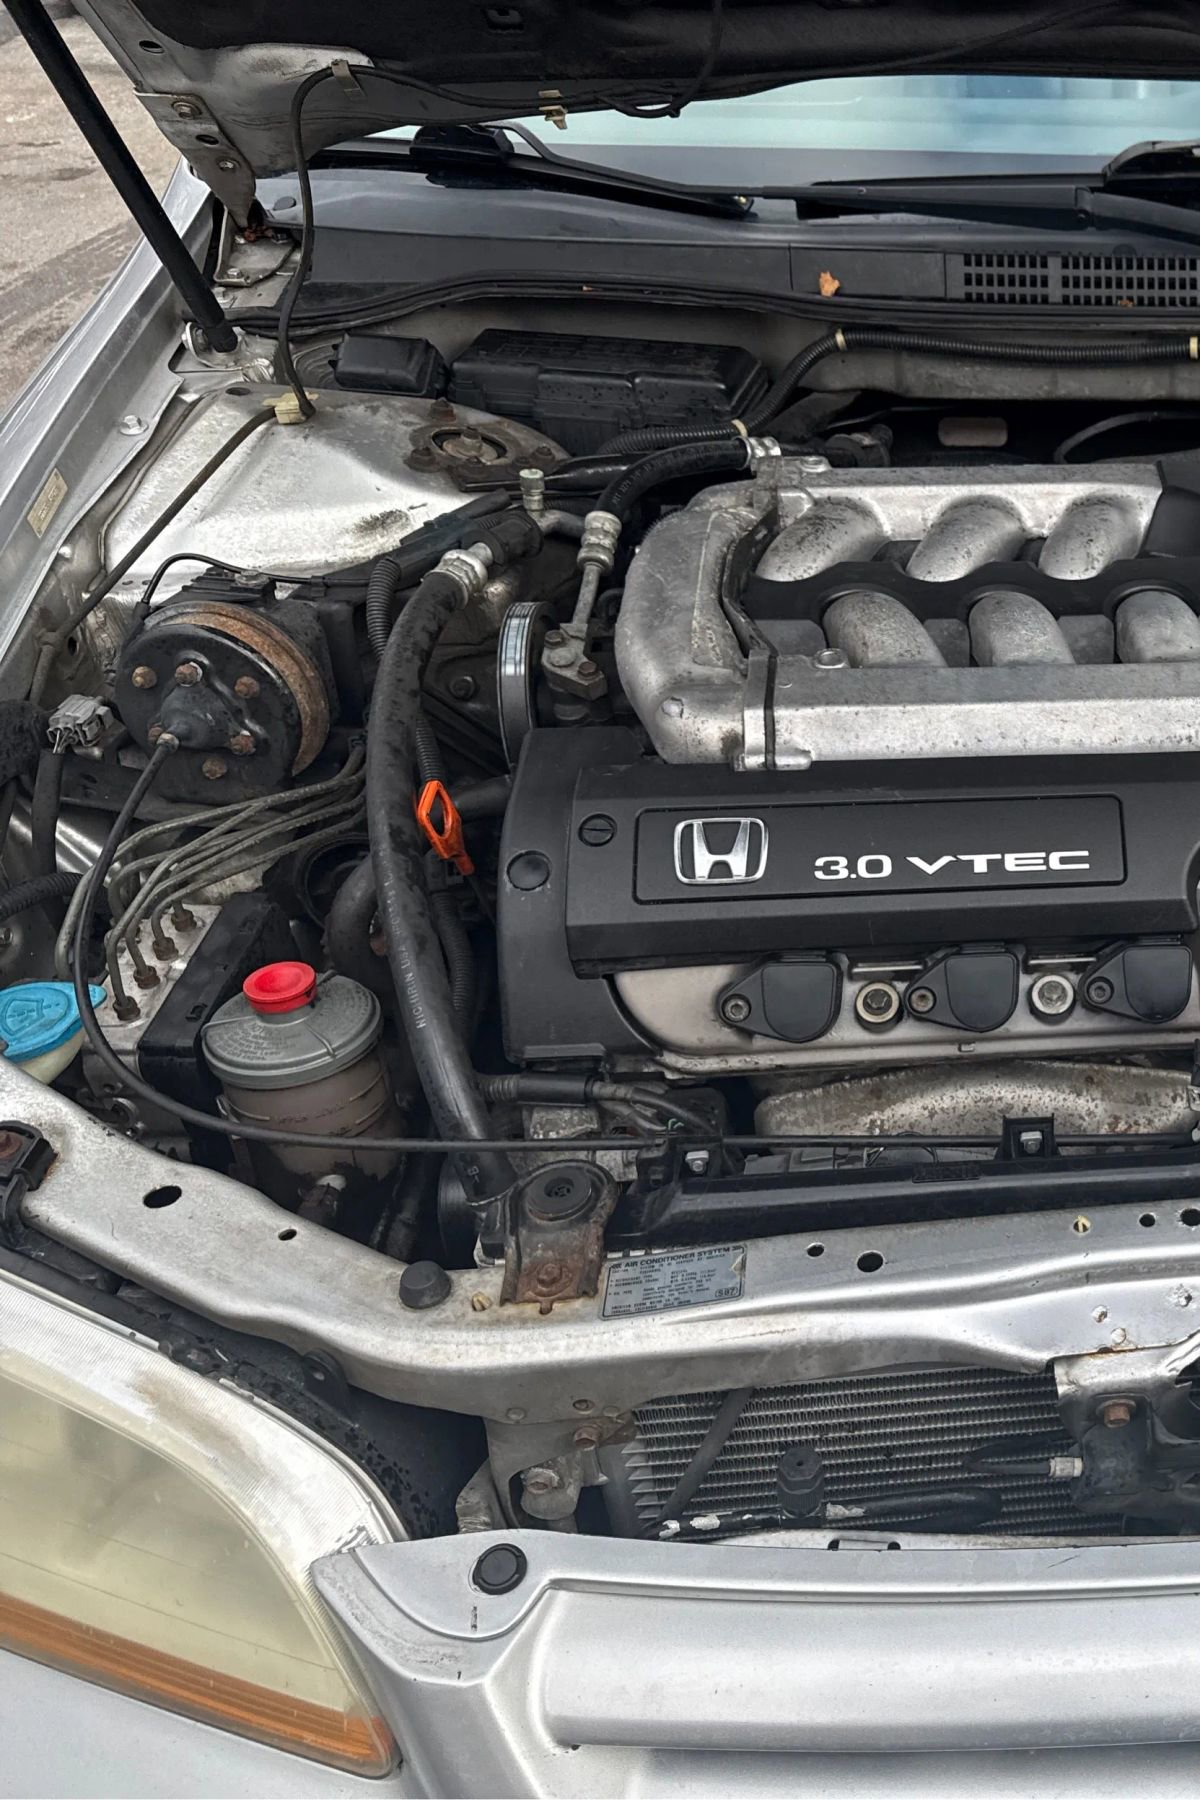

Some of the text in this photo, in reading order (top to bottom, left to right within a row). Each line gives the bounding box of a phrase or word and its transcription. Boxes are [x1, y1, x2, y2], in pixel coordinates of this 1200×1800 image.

[814, 849, 1091, 881] 3.0 VTEC
[404, 972, 427, 1029] NICHIRIN
[640, 1252, 696, 1267] CONDITIONER
[697, 1247, 731, 1258] SYSTEM
